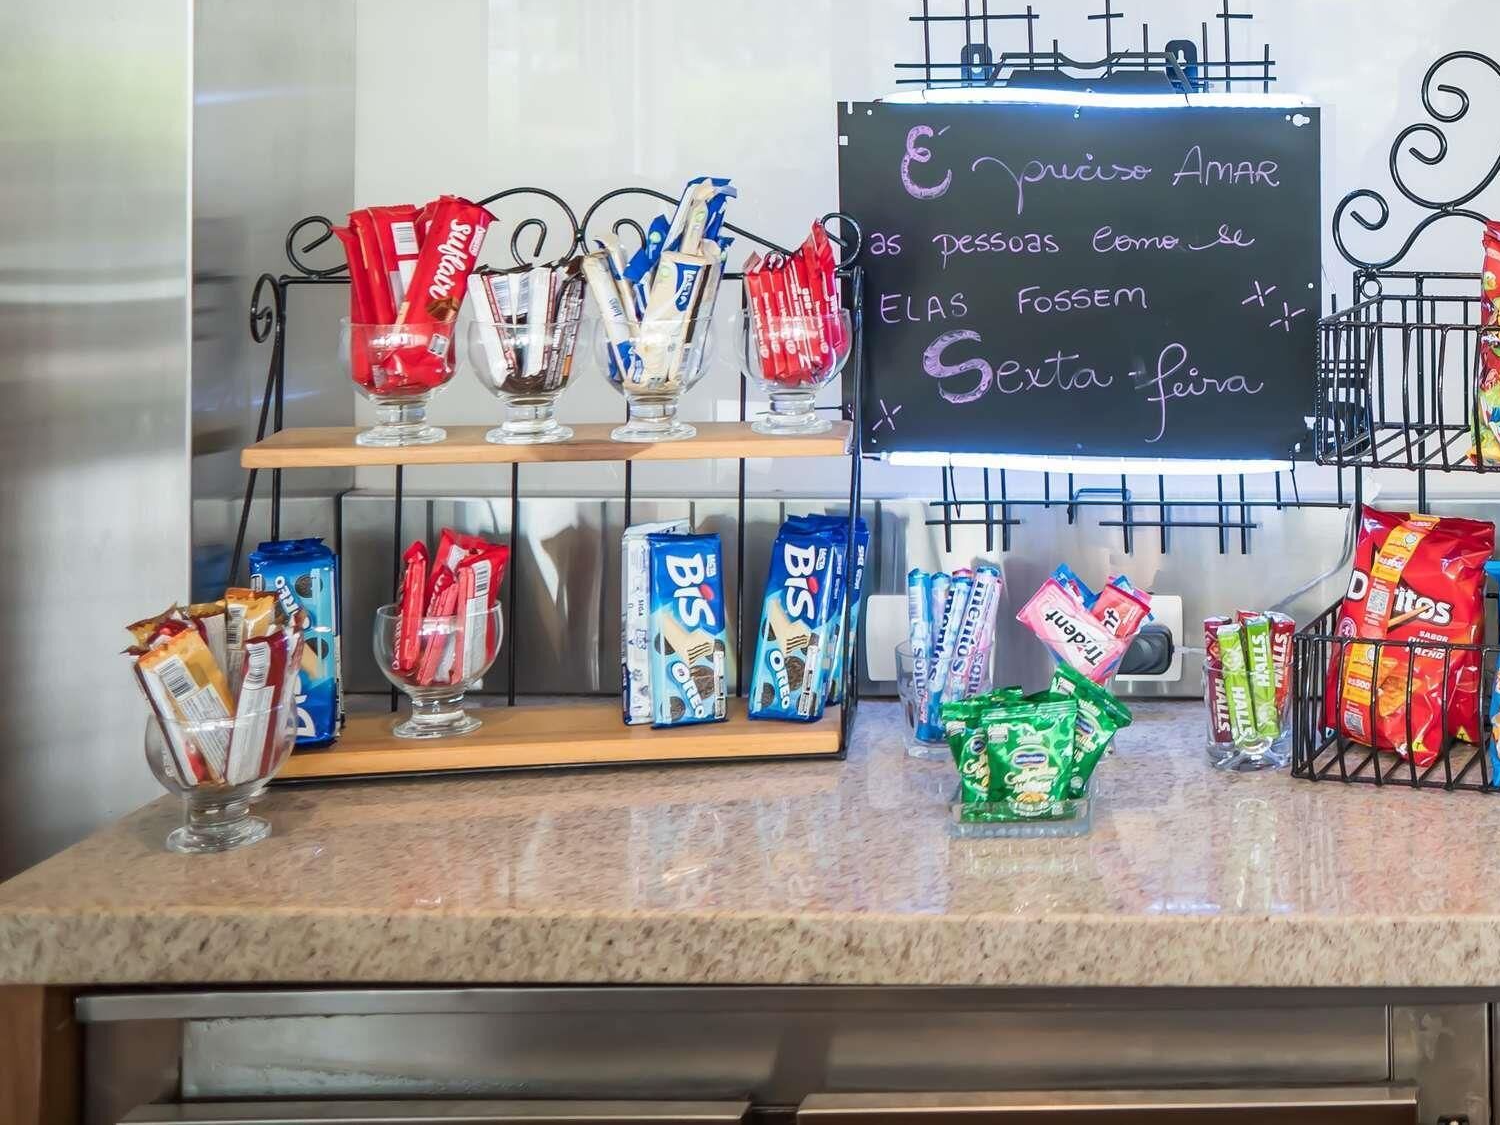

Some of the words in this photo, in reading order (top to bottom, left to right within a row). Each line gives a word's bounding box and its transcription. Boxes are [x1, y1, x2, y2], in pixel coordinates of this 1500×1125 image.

[972, 153, 1153, 215] preciso
[1172, 145, 1281, 188] AMAR
[869, 233, 903, 256] as
[932, 231, 1061, 270] pessoas
[1188, 223, 1257, 252] se
[879, 292, 968, 324] ELAS
[951, 581, 986, 674] mentos
[1045, 610, 1104, 666] Trident
[1419, 630, 1449, 642] SABOR
[769, 650, 791, 709] OREO
[1252, 632, 1271, 687] HALLS
[671, 662, 704, 719] OREO
[1214, 678, 1231, 733] HALLS
